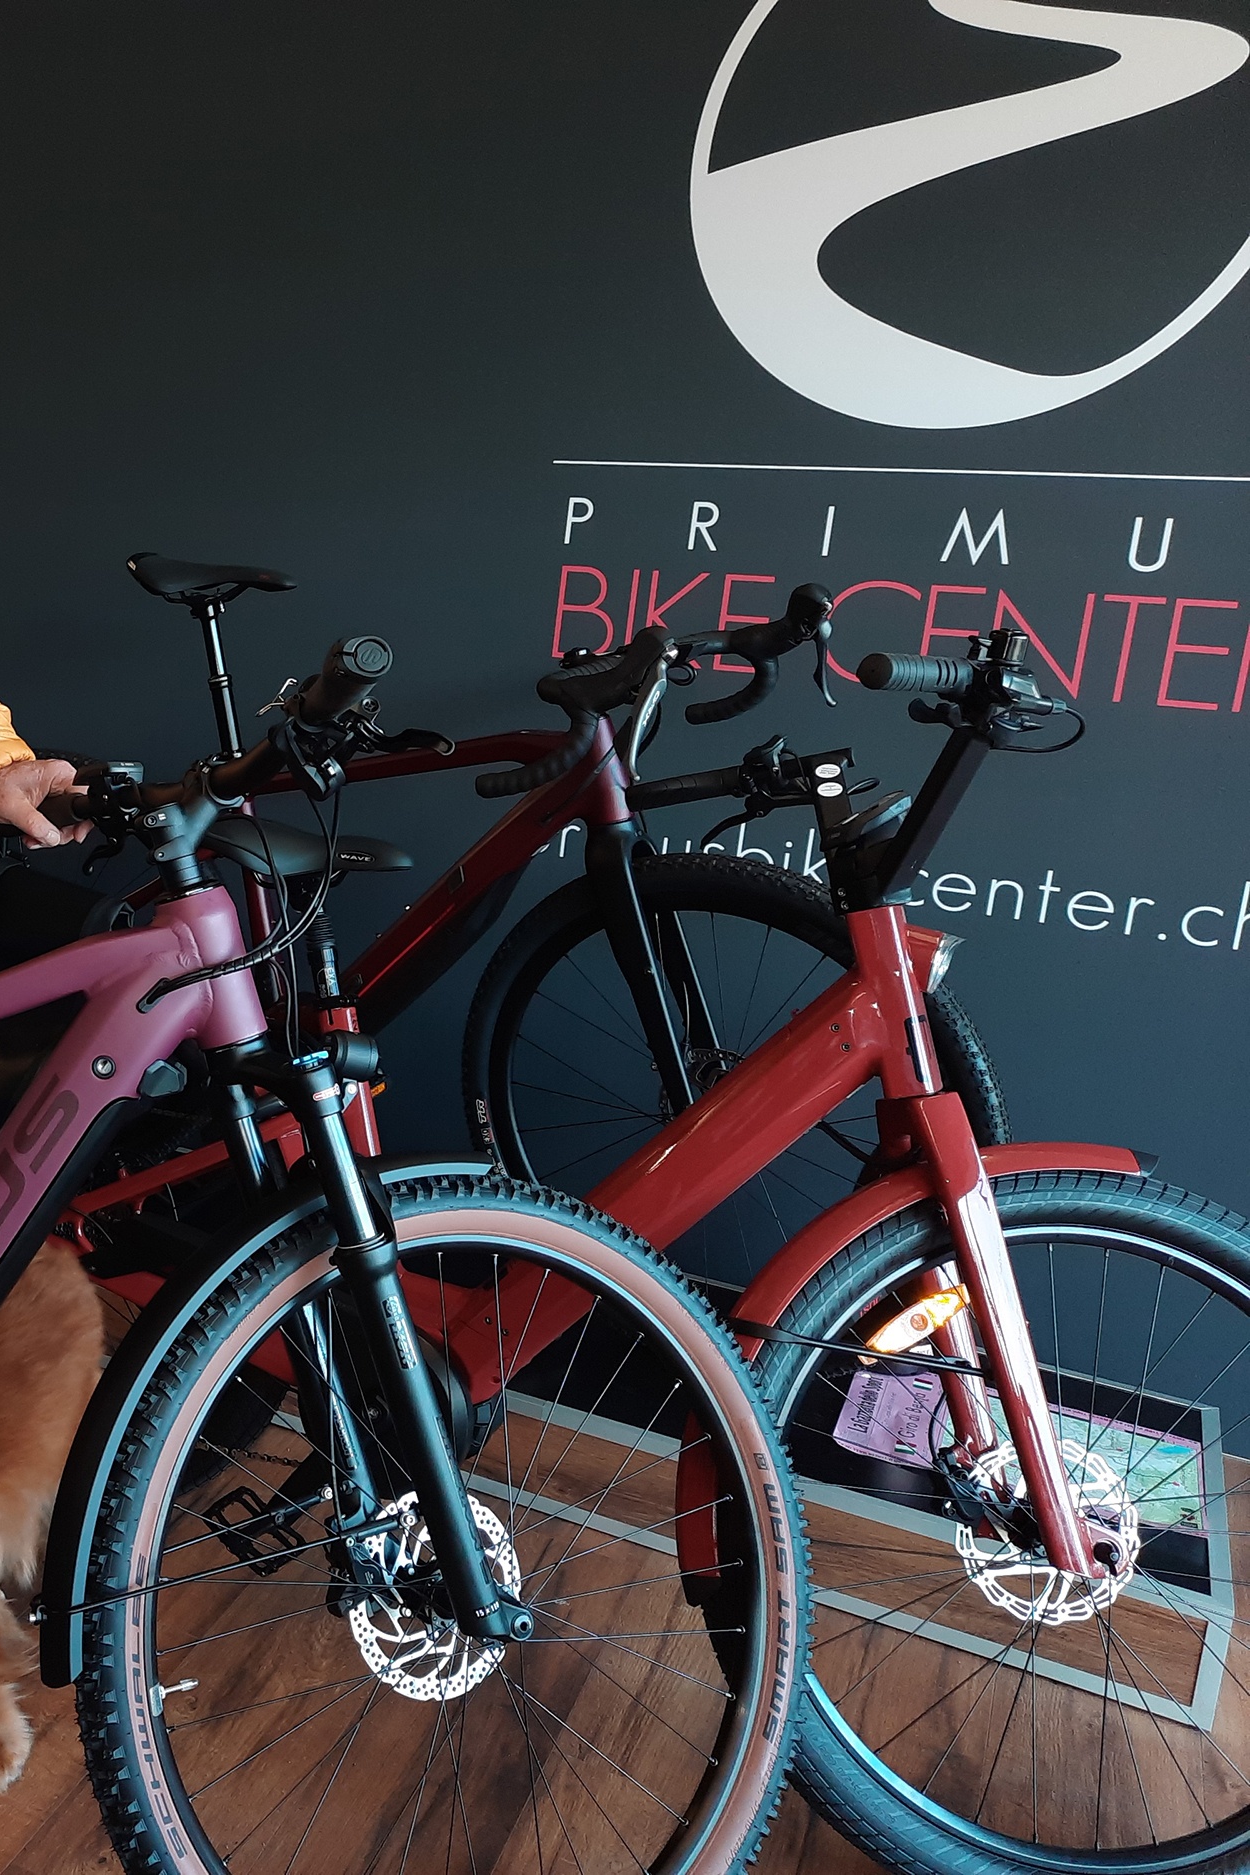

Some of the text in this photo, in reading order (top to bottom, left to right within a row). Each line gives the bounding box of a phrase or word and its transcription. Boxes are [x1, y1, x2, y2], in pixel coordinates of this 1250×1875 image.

[551, 565, 1250, 713] BIKE CENTE
[340, 853, 372, 861] WAVE
[762, 1483, 791, 1745] SMART SAM
